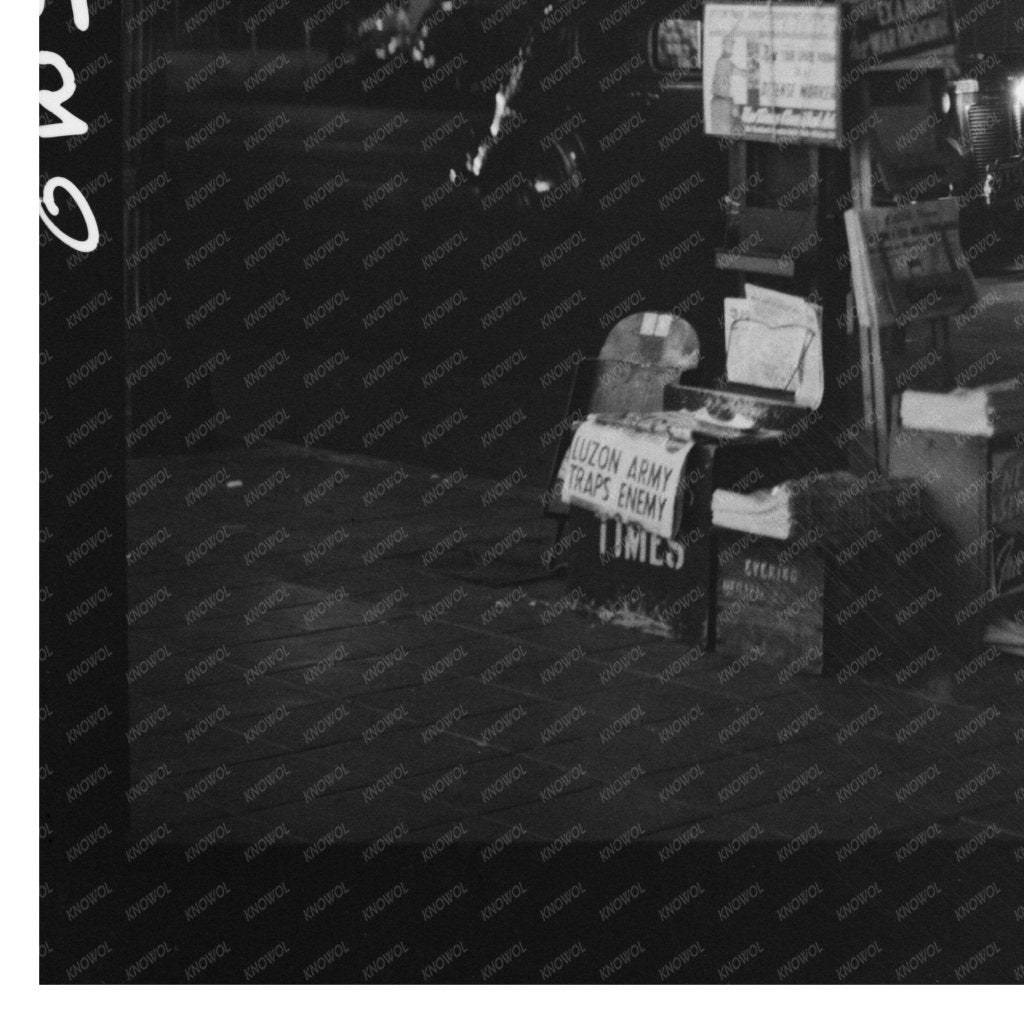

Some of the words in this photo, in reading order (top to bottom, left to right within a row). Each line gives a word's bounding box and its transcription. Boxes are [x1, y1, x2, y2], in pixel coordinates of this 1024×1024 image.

[568, 463, 611, 502] TRAPS
[617, 483, 667, 521] ENEMY
[572, 436, 622, 475] LUZON
[627, 456, 673, 492] ARMY
